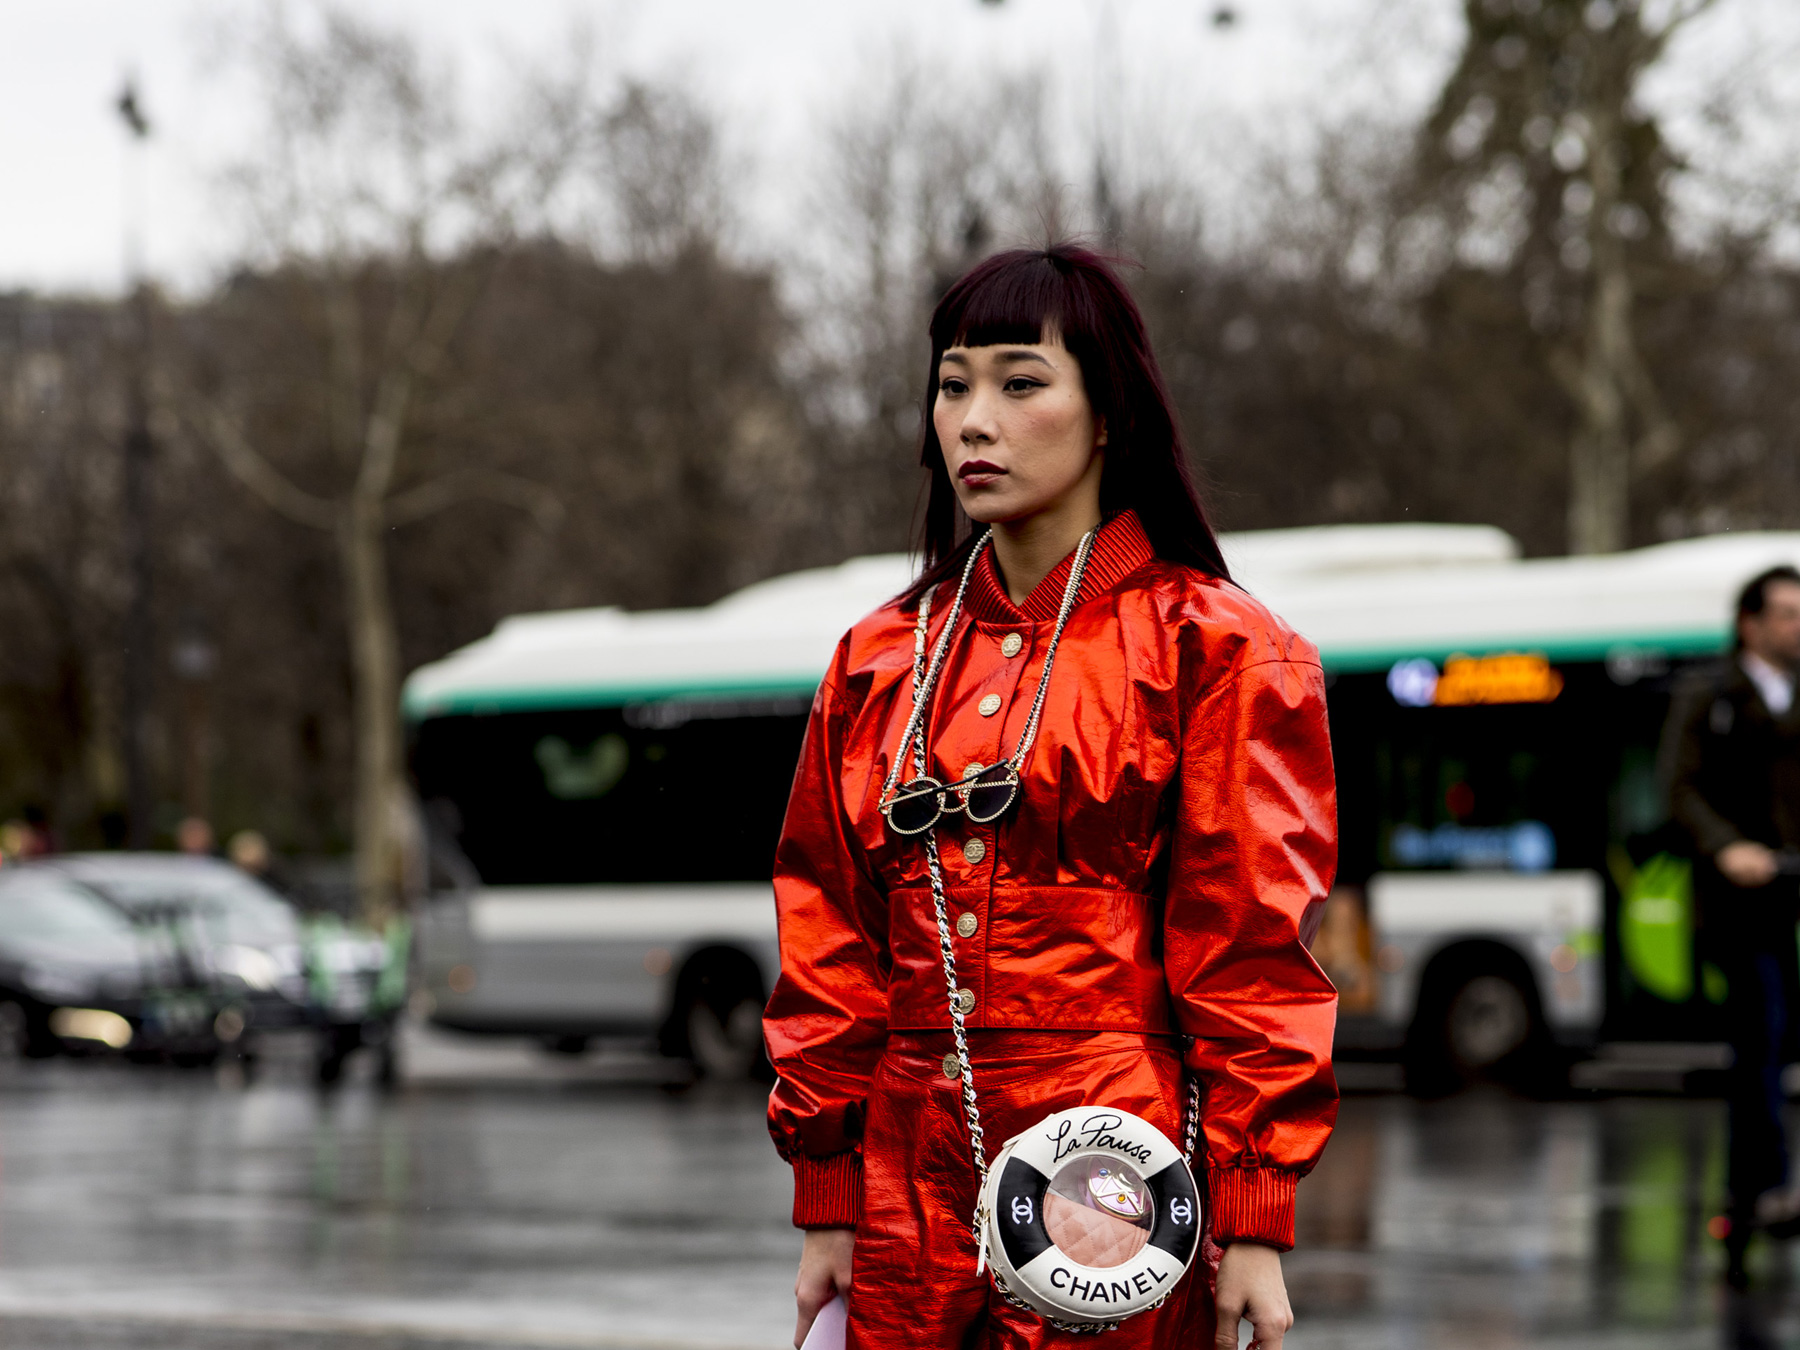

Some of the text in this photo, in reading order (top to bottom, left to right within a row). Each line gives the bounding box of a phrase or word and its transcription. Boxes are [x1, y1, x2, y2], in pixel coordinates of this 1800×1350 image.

[1046, 1114, 1152, 1164] La Pausa
[1050, 1267, 1169, 1303] CHANEL
